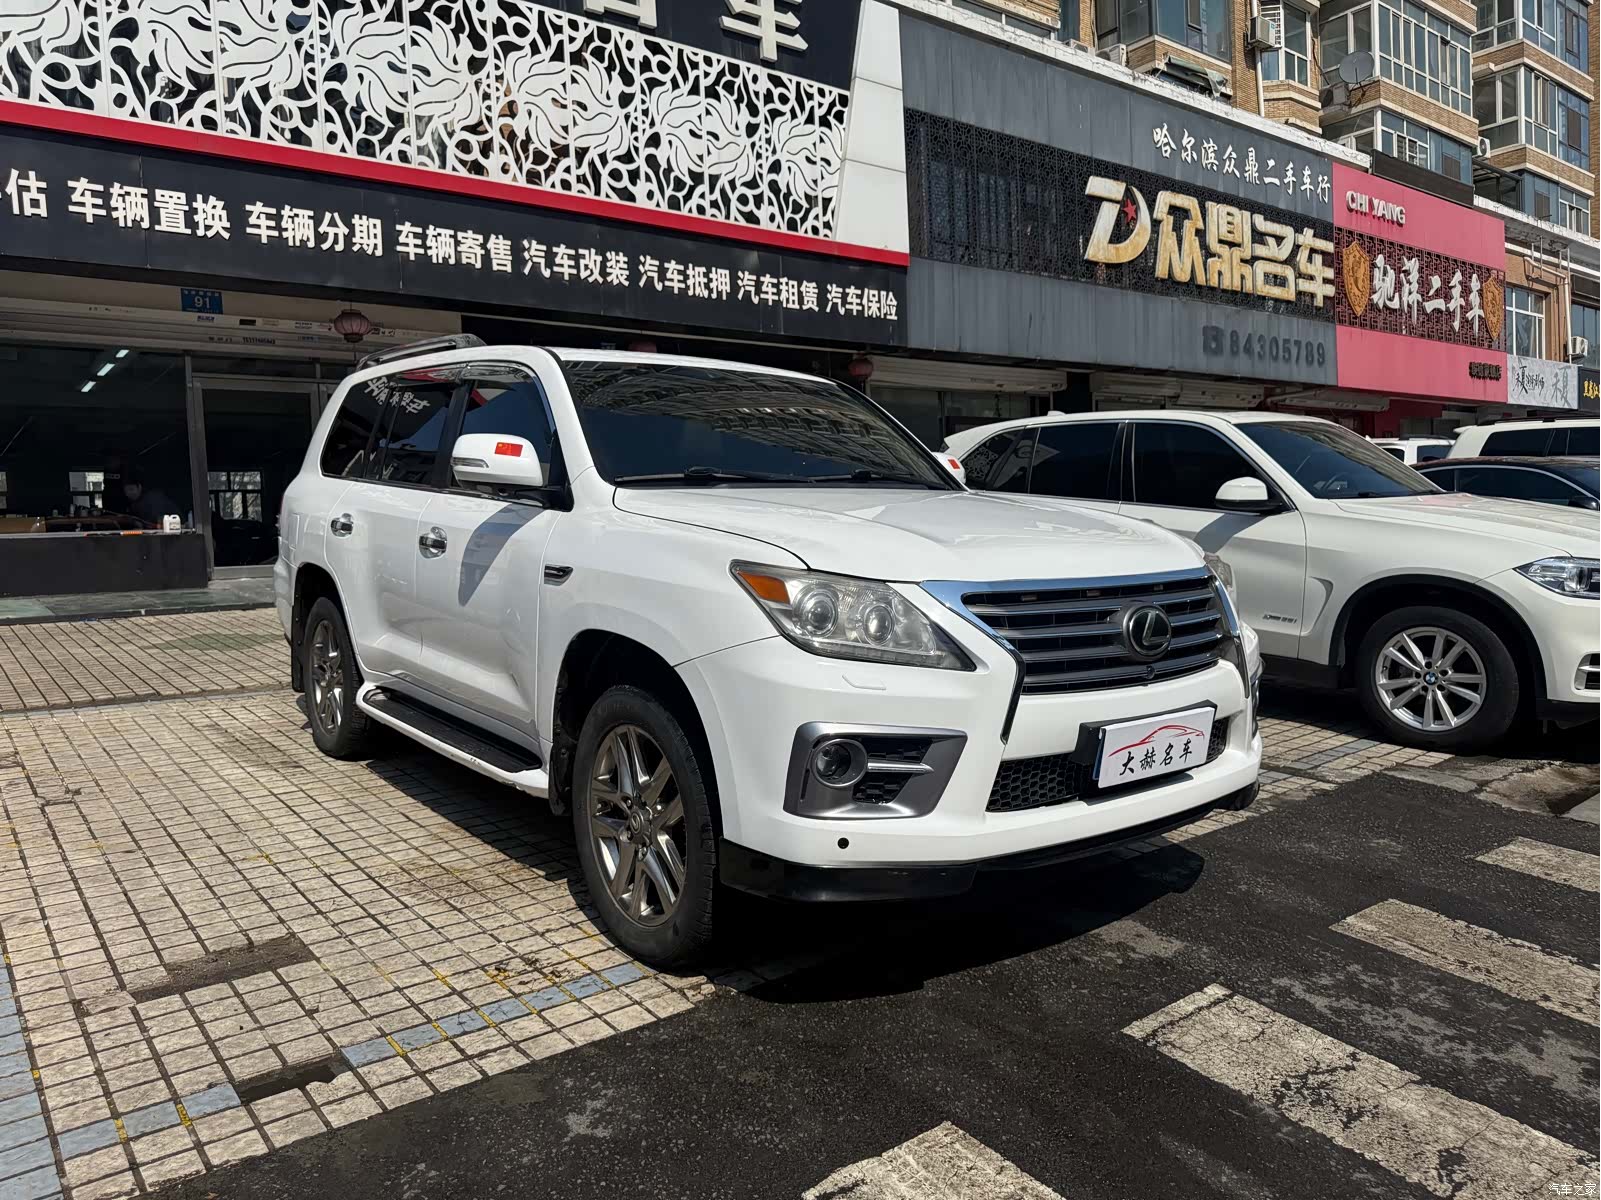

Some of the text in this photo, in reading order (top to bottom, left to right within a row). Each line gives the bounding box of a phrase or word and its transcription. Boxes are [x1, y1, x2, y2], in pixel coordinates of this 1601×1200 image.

[1153, 123, 1331, 204] 哈尔滨众鼎二手车行
[1345, 190, 1406, 225] CHI YANG
[0, 168, 899, 321] 估 车辆置换 车辆分期 车辆寄售 汽车改装 汽车抵押 汽车租赁 汽车保险
[1153, 190, 1336, 308] 众鼎名车
[194, 296, 211, 309] 91
[1228, 329, 1326, 368] 84305789
[1119, 737, 1193, 776] 大赫名车
